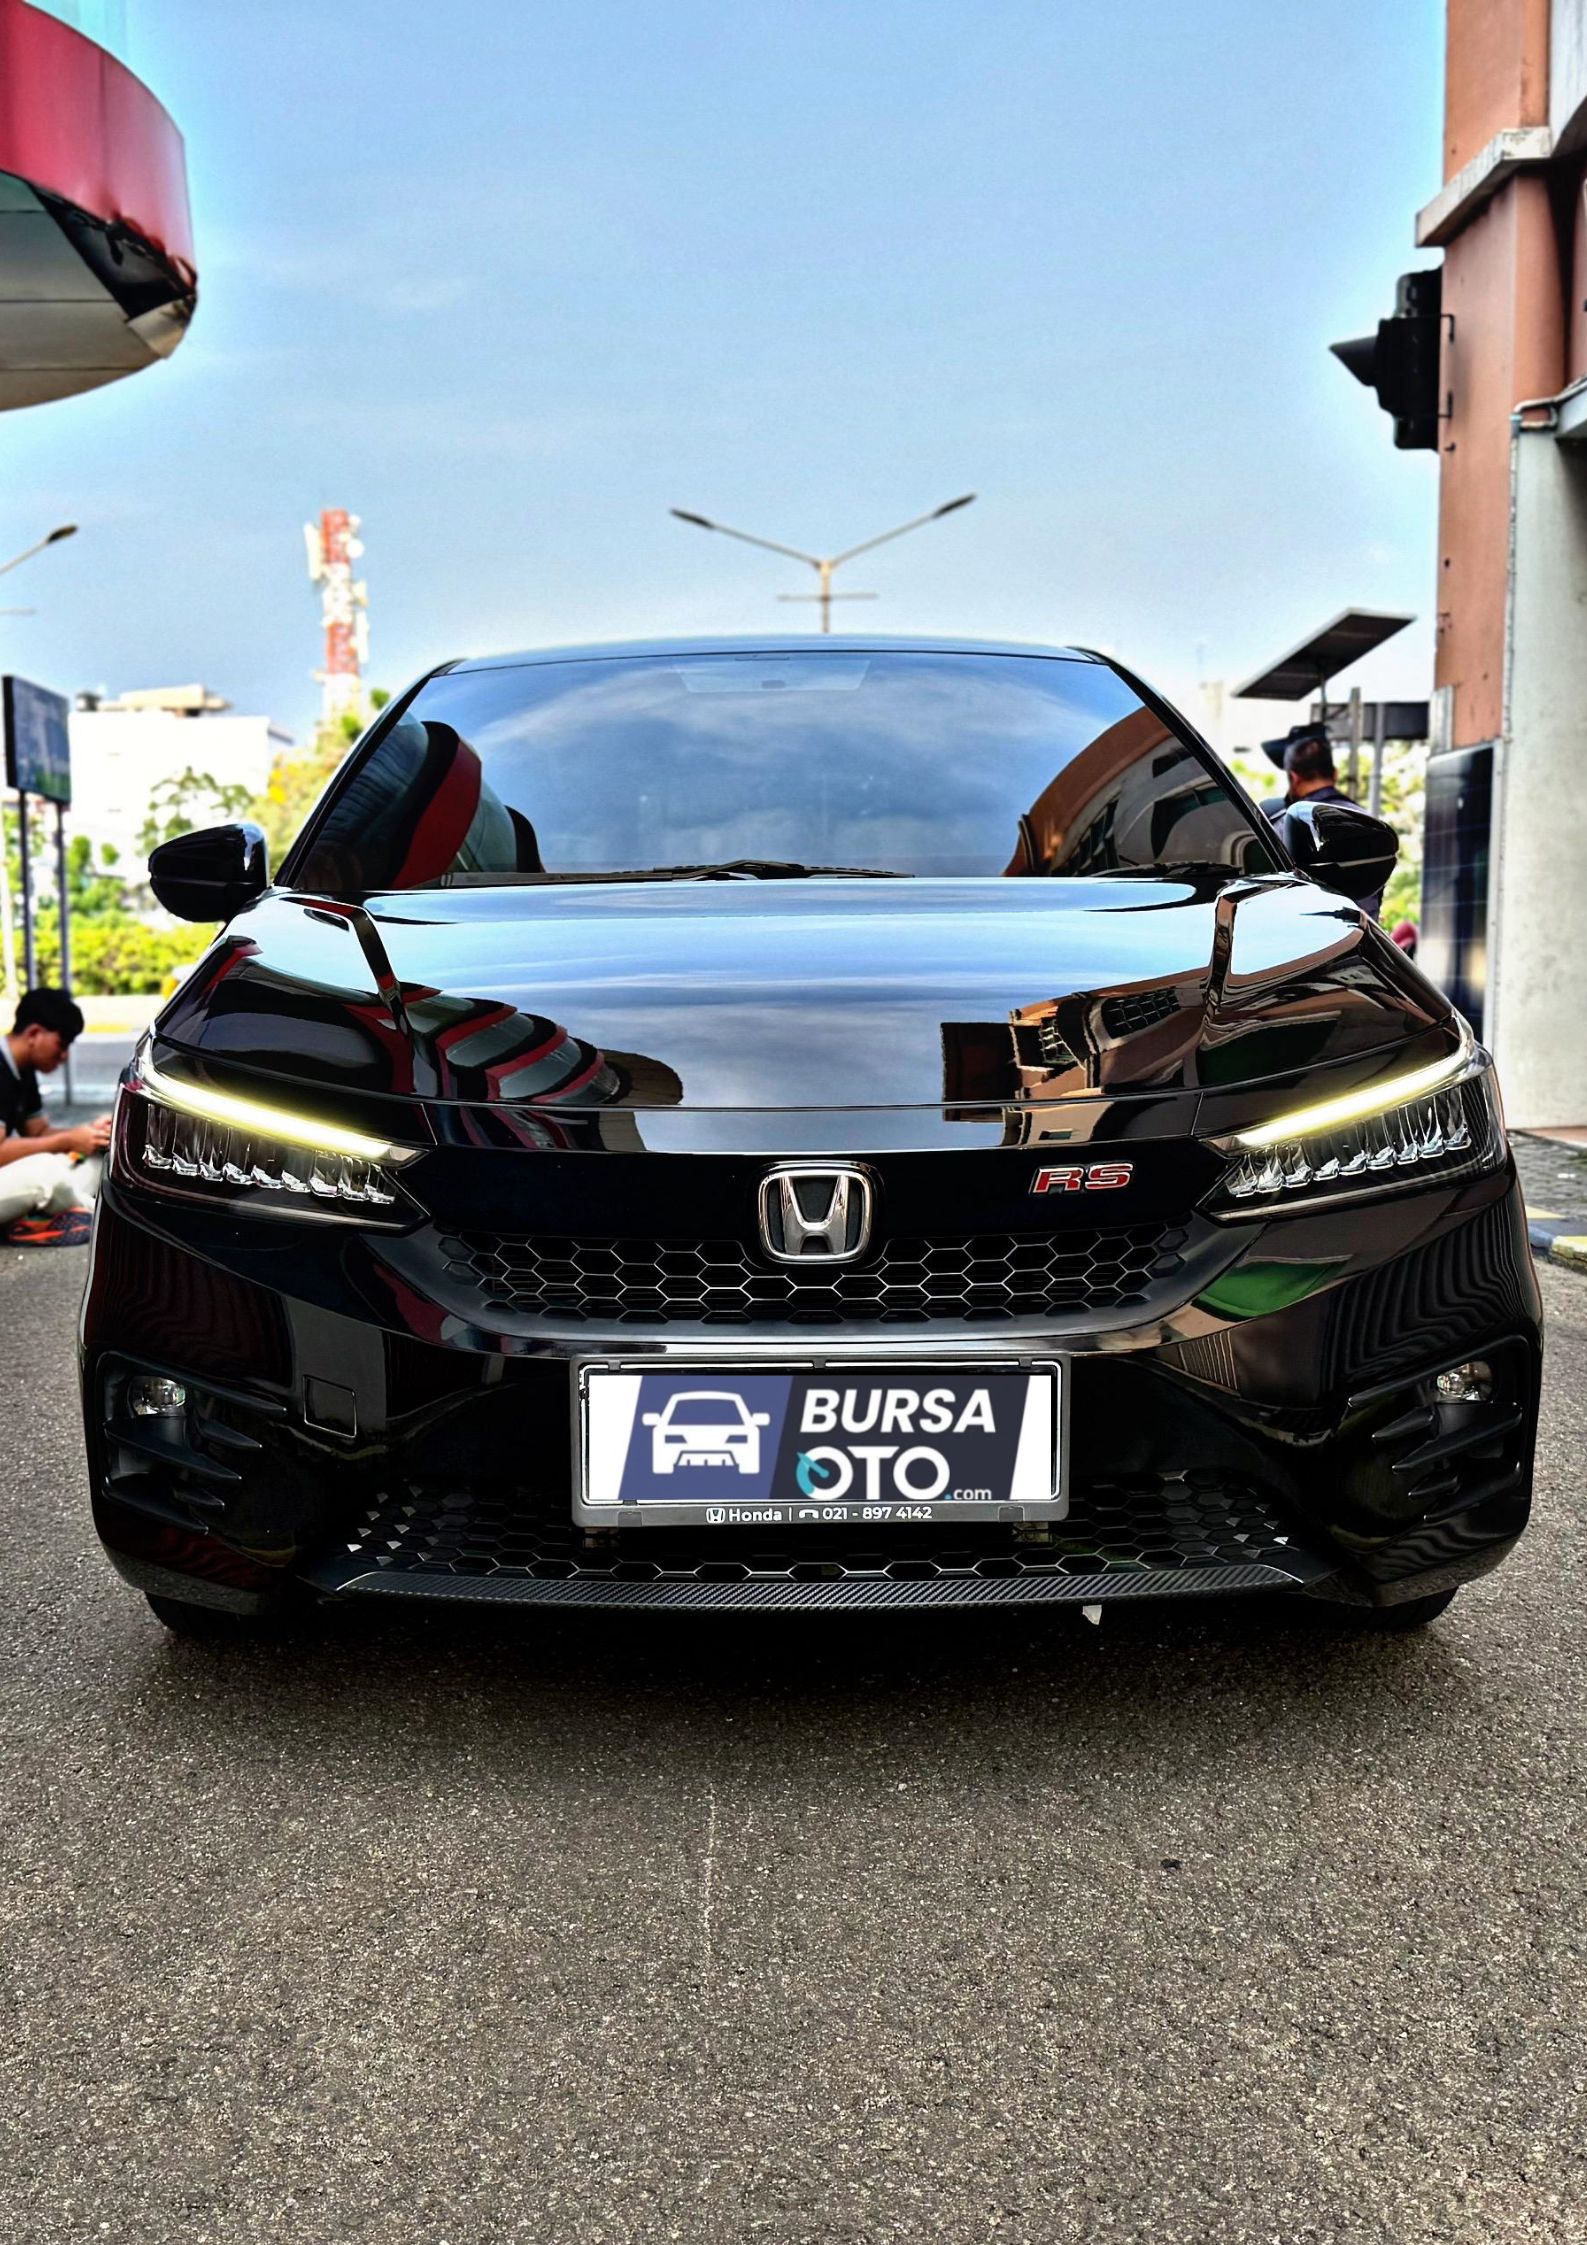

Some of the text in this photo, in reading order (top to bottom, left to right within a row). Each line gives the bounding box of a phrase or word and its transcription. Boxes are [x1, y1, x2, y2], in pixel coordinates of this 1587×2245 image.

[1032, 1162, 1134, 1194] RS
[728, 1507, 782, 1522] Honda
[822, 1507, 848, 1520] 021
[862, 1506, 893, 1520] 897
[895, 1506, 933, 1519] 4142
